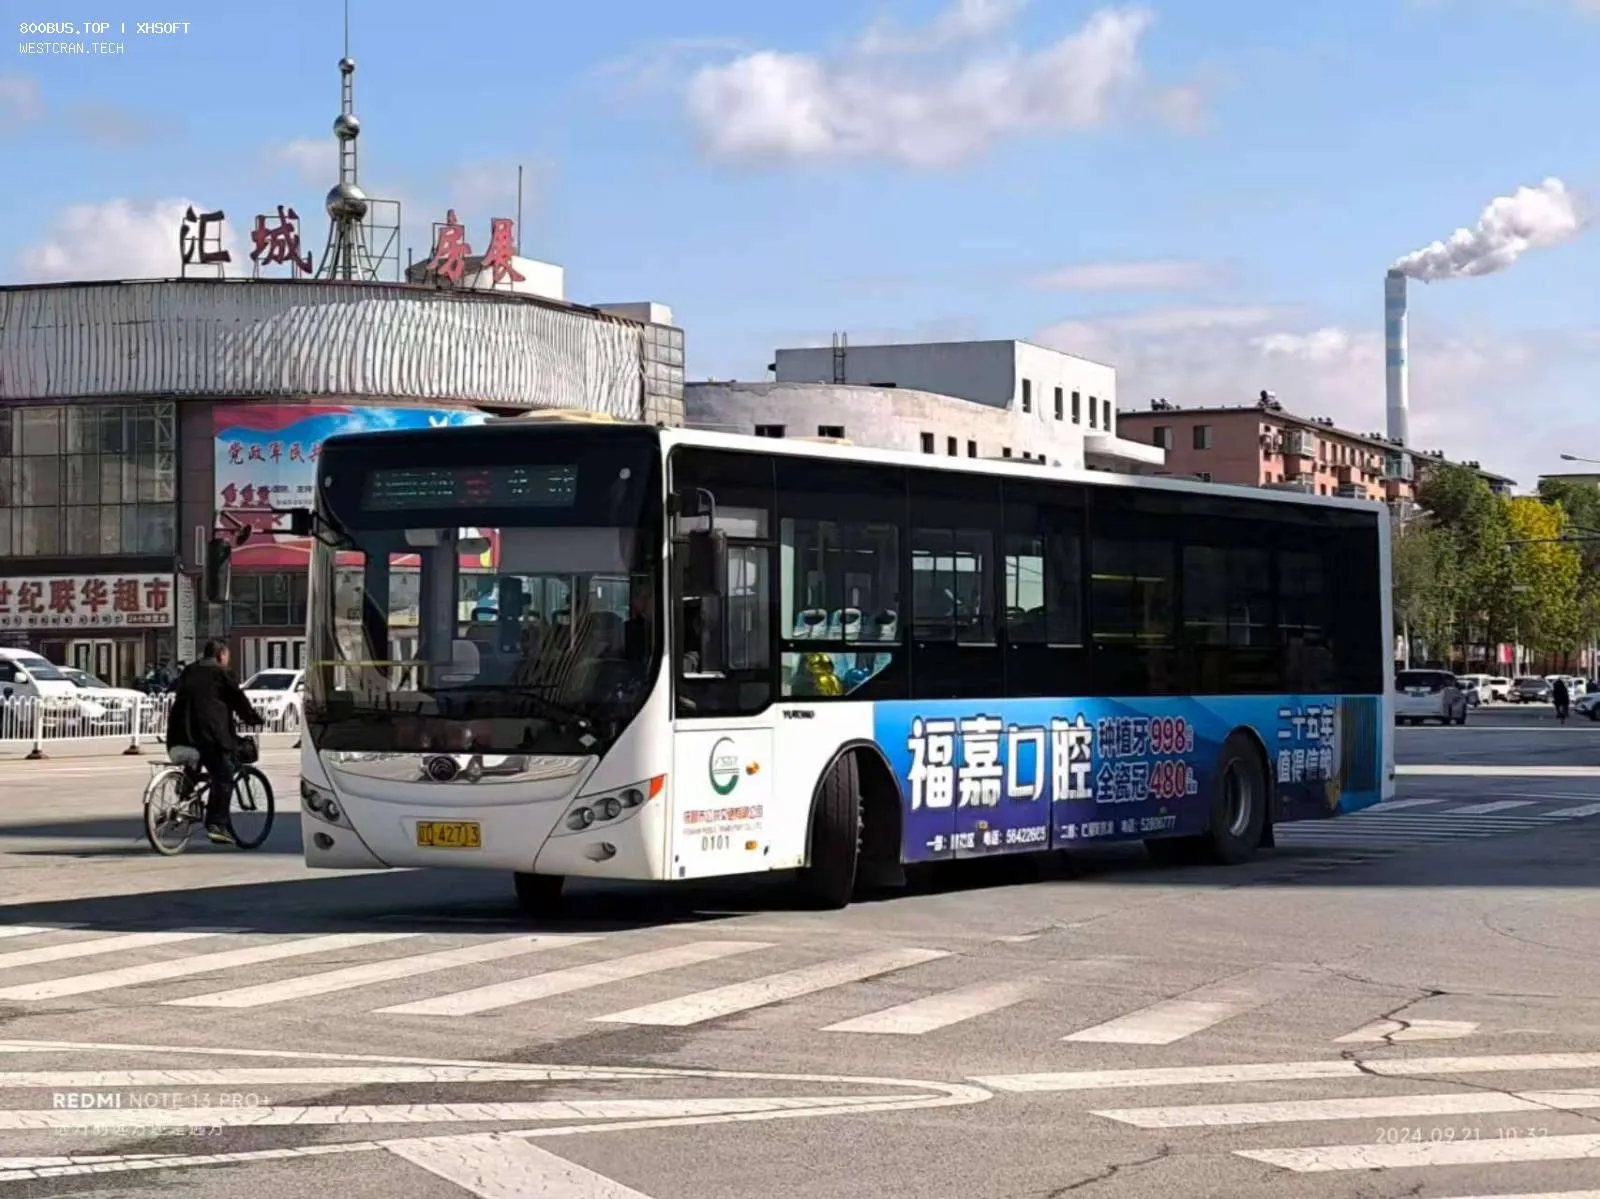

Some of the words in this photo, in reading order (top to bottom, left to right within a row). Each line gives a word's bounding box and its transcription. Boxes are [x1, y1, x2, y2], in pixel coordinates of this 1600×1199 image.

[907, 712, 1094, 811] 福嘉口腔
[702, 835, 731, 851] 0101
